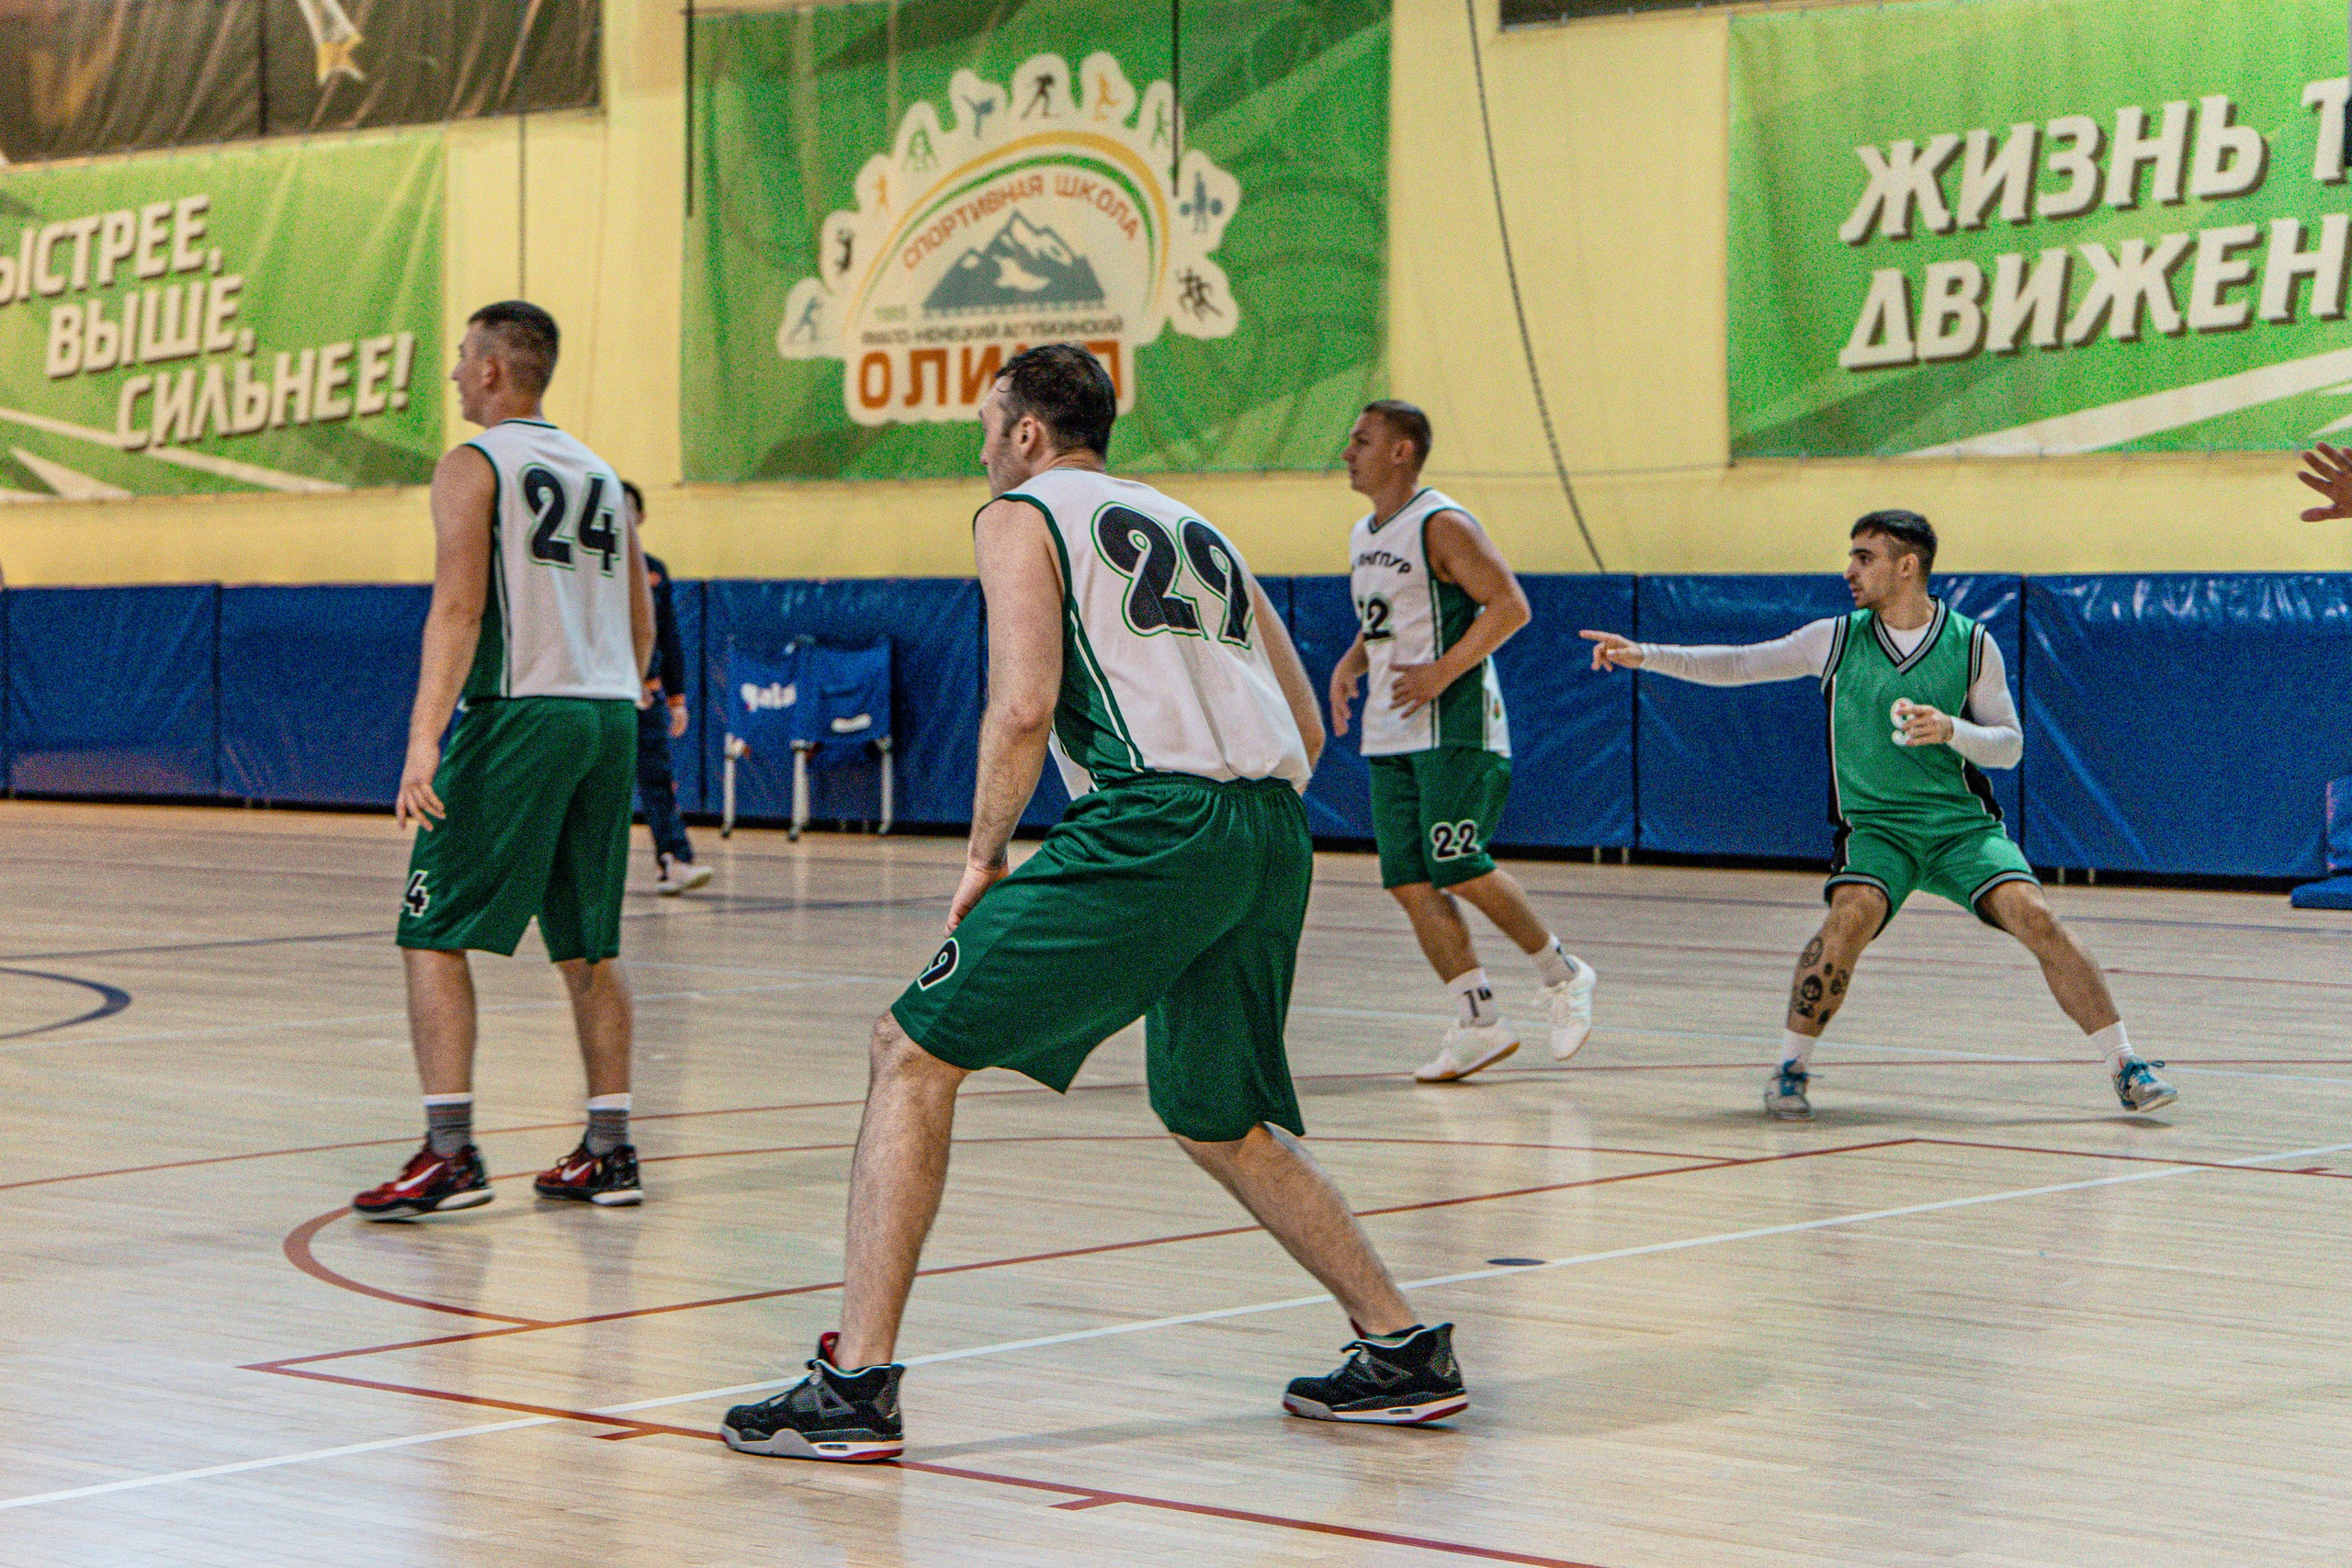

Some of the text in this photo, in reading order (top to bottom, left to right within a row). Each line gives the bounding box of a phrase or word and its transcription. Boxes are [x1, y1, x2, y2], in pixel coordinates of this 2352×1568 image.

[901, 174, 1138, 270] СПОРТИВНАЯ ШКОЛА
[1839, 95, 2270, 246] ЖИЗНЬ
[47, 275, 257, 380] ВЫШЕ,
[1838, 214, 2352, 372] ДВИЖЕН
[117, 332, 416, 451] СИЛЬНЕЕ!
[858, 340, 1123, 410] ОЛИП
[520, 464, 620, 576] 24
[1091, 502, 1253, 649] 29
[1430, 819, 1481, 863] 22
